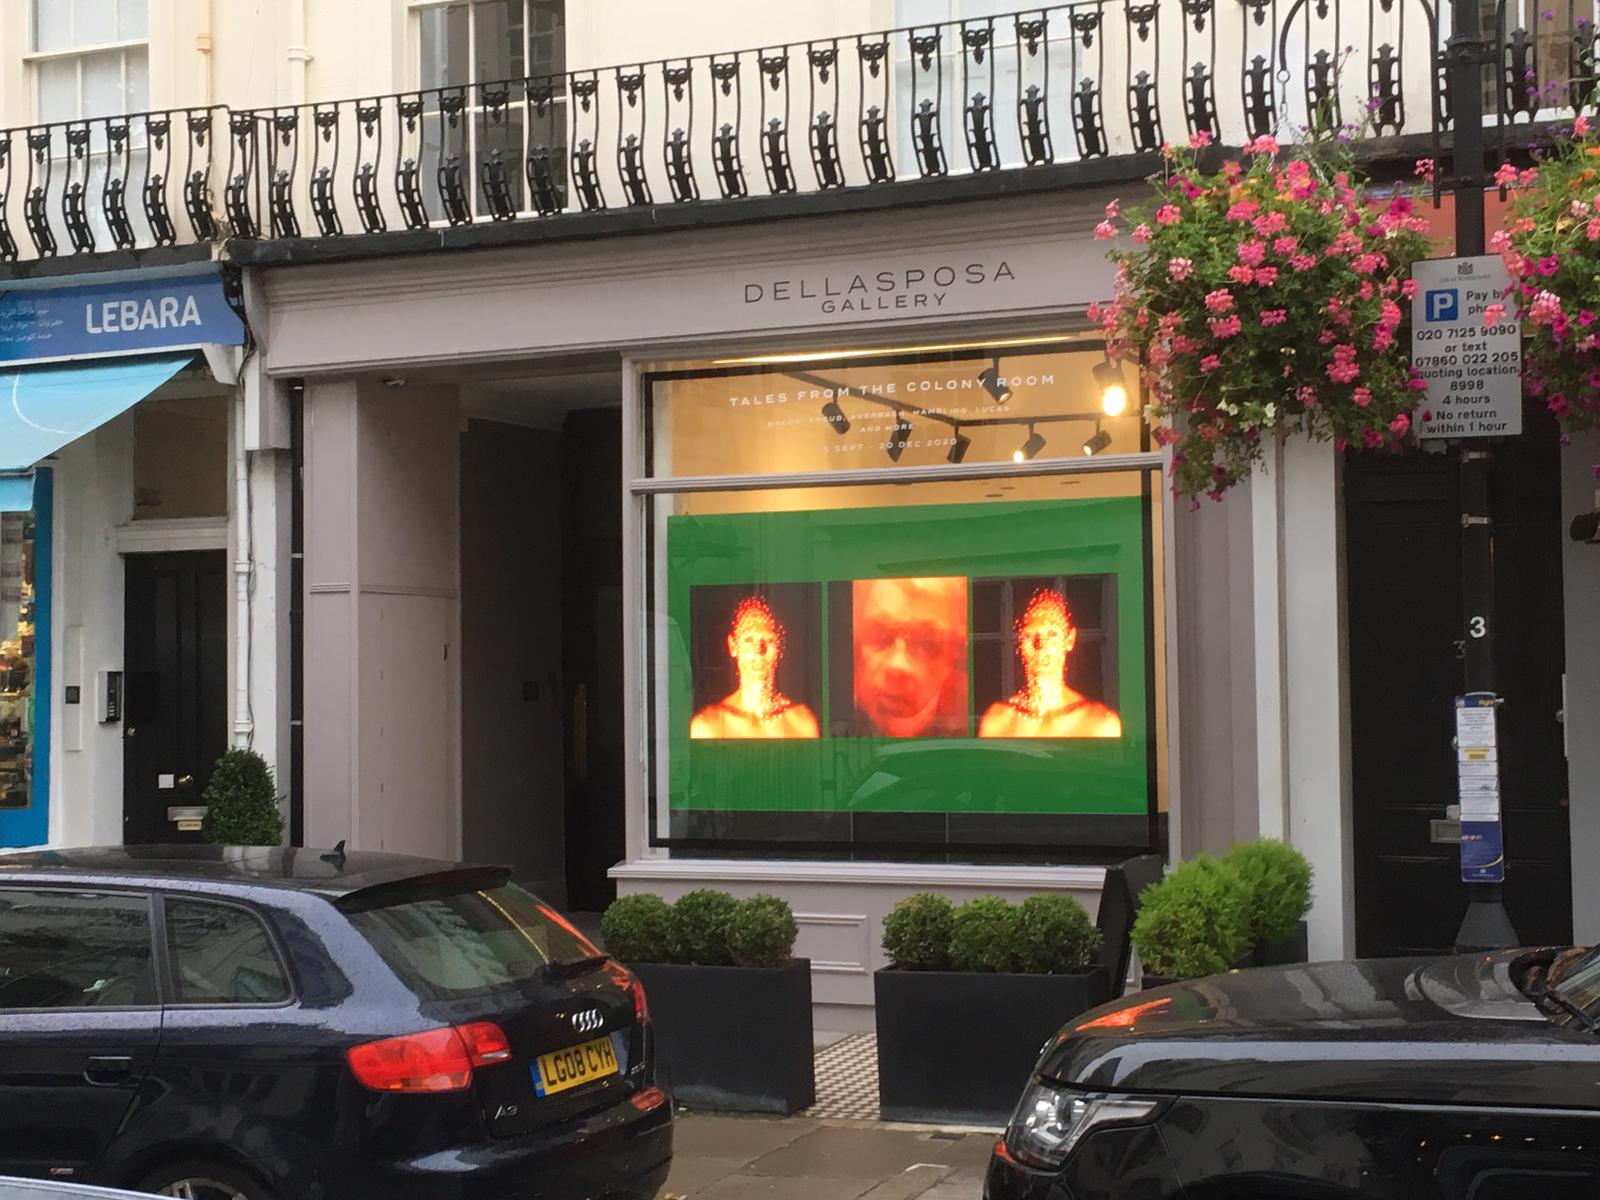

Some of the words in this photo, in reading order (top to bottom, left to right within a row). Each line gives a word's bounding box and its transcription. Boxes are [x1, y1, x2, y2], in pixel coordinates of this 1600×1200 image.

[744, 261, 1015, 303] DELLASPOSA
[821, 293, 947, 313] GALLERY
[1466, 290, 1488, 302] Pay
[86, 295, 201, 334] LEBARA
[1416, 330, 1443, 341] 020
[1448, 327, 1476, 338] 7125
[1481, 325, 1516, 337] 9090
[1445, 344, 1457, 353] or
[1462, 341, 1488, 352] text
[1415, 355, 1457, 367] 07860
[1463, 354, 1487, 365] 022
[1492, 352, 1518, 363] 205
[1418, 367, 1463, 379] quoting
[1467, 365, 1517, 376] location
[729, 393, 788, 407] TALES
[798, 387, 849, 400] FROM
[860, 383, 897, 395] THE
[907, 379, 986, 392] COLONY
[996, 375, 1055, 388] ROOM
[1450, 380, 1485, 391] 8998
[1442, 395, 1451, 405] 4
[1456, 394, 1491, 404] hours
[1436, 410, 1453, 421] No
[1458, 408, 1497, 419] return
[885, 423, 914, 431] MORE
[1427, 423, 1465, 434] within
[1469, 421, 1475, 432] 1
[1478, 420, 1507, 432] hour
[898, 439, 921, 448] DEC
[927, 438, 957, 447] 2020
[1469, 616, 1487, 639] 3
[542, 1049, 586, 1087] LG08
